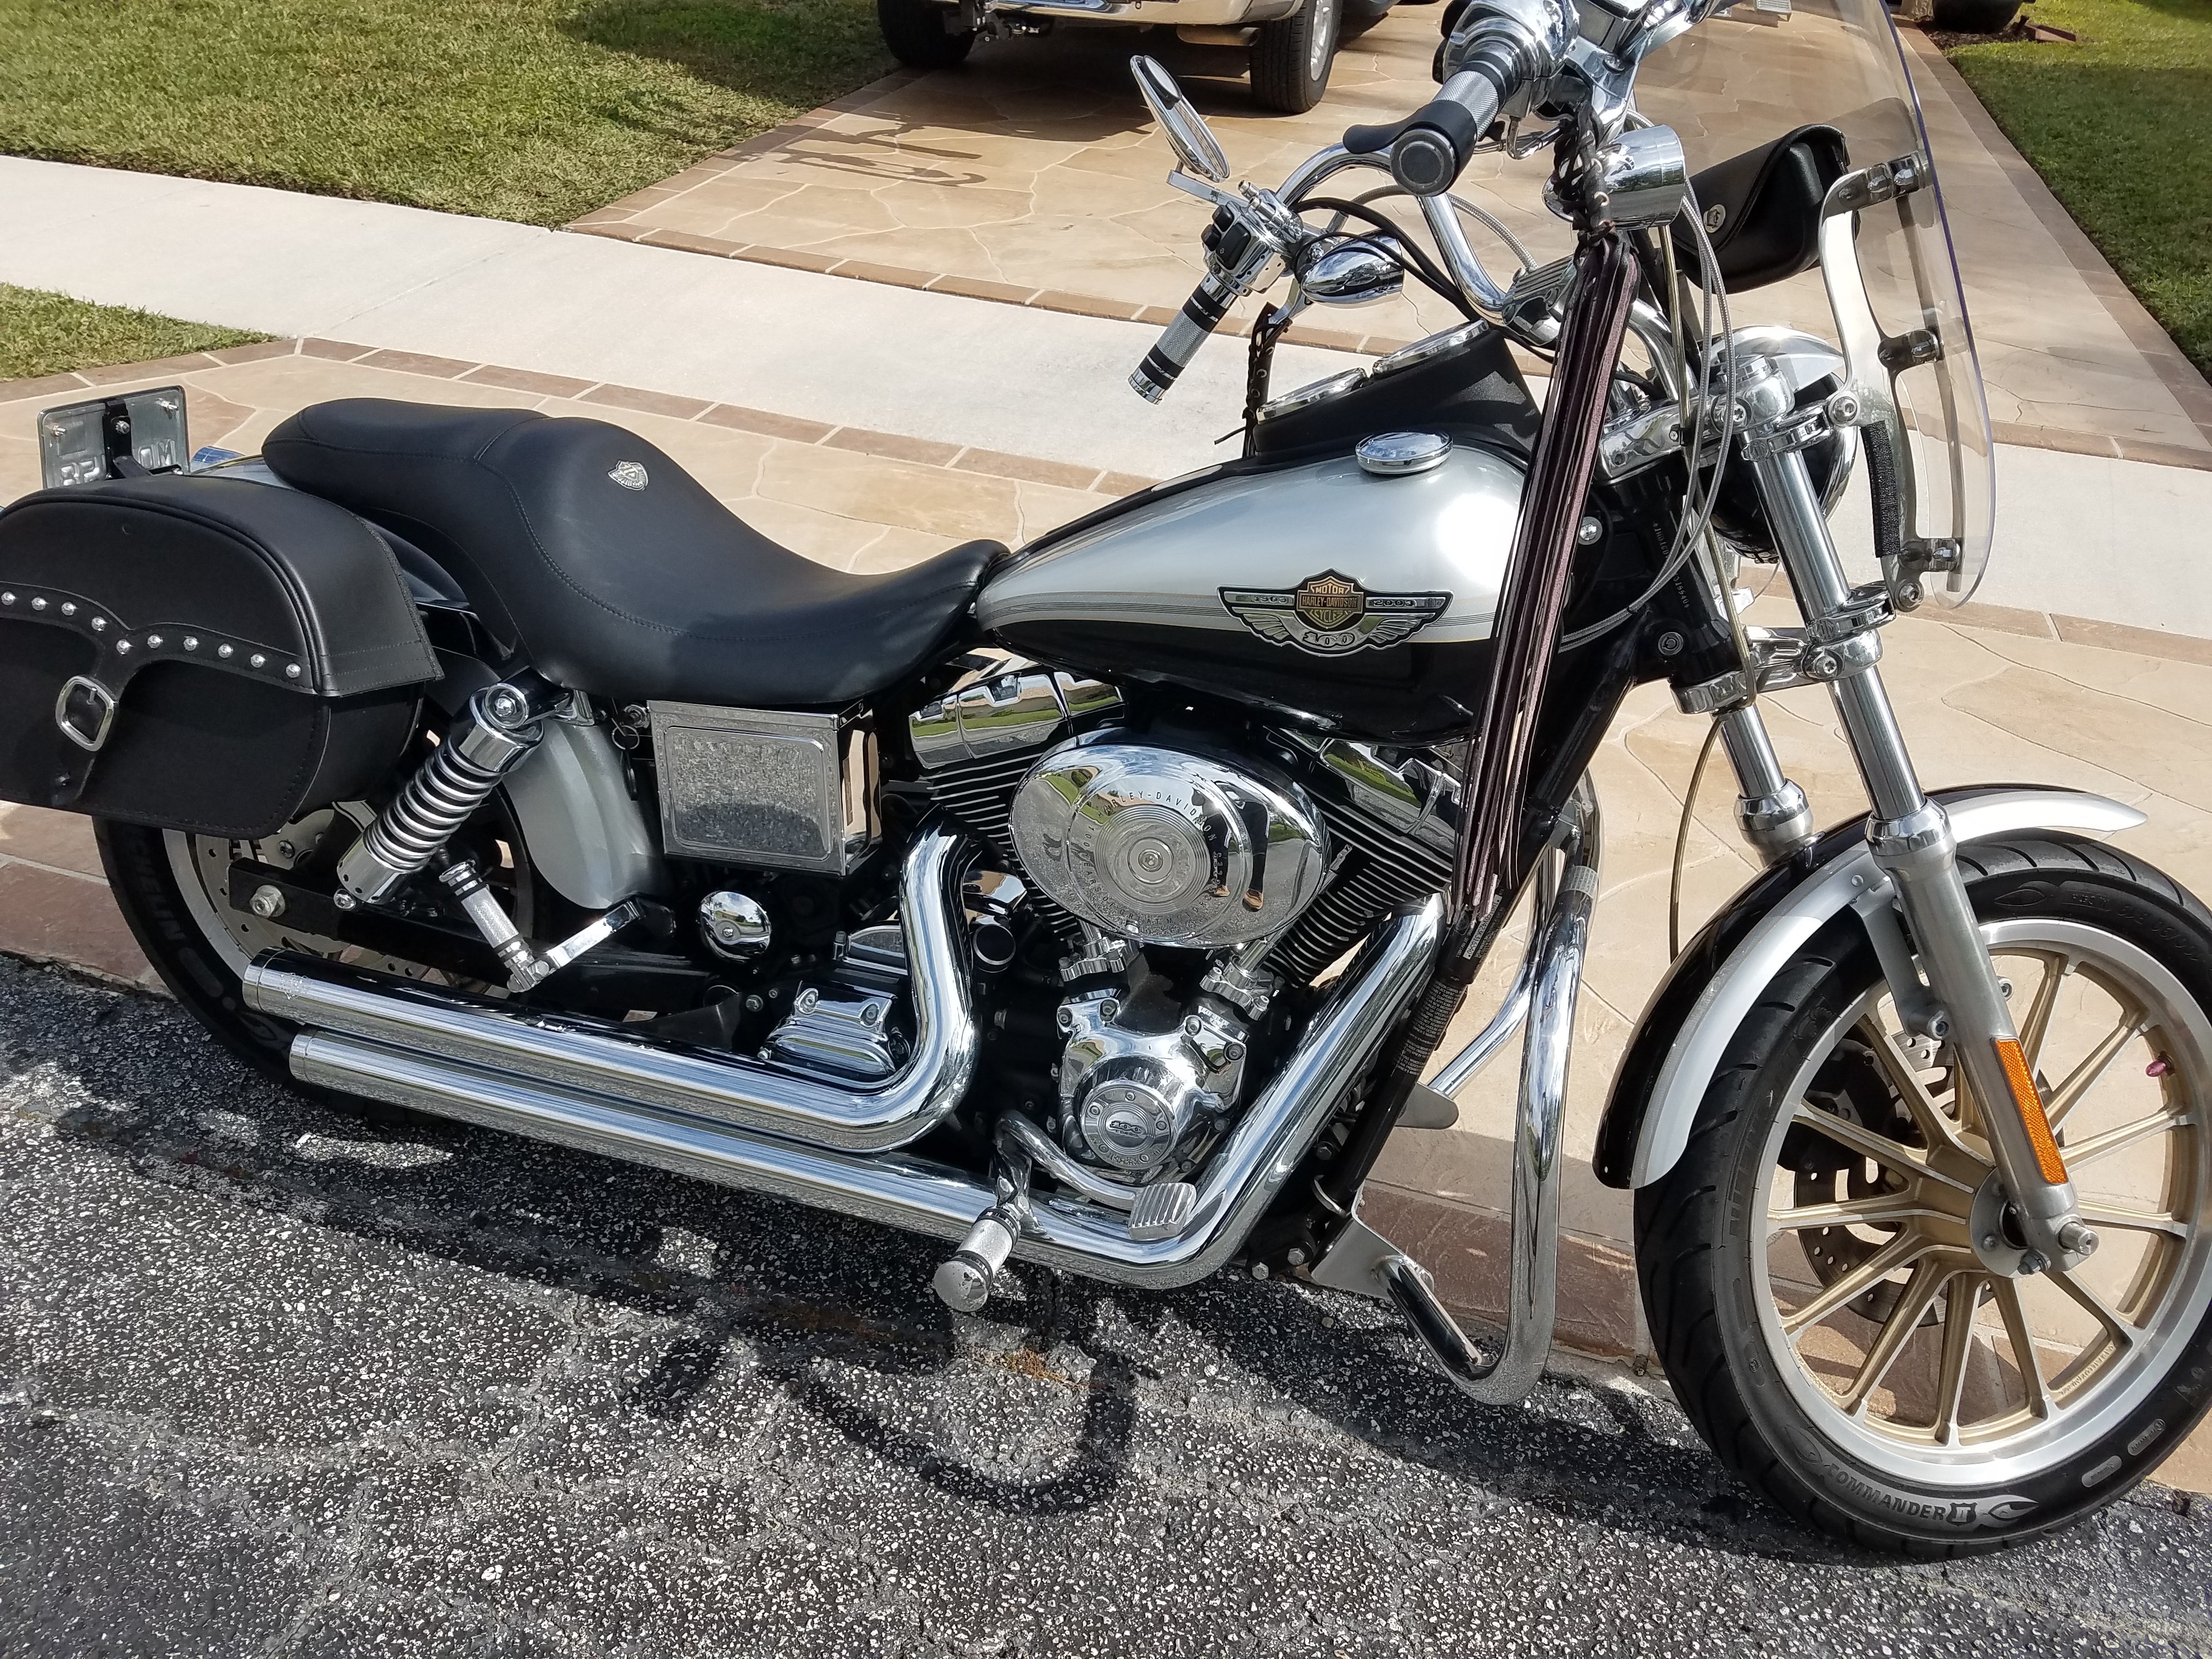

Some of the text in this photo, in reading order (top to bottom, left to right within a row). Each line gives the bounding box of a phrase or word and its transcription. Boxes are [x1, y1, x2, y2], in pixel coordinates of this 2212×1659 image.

[1316, 583, 1345, 594] MOTOR
[1302, 596, 1357, 608] HARLEY-DAVIDSON
[1314, 610, 1343, 623] CYCLES
[1302, 632, 1355, 648] 100
[1097, 791, 1217, 841] HARLEY-DAVIDSON
[1083, 826, 1095, 847] 100
[1081, 851, 1102, 892] YEARS
[1120, 909, 1160, 924] GREAT
[1110, 1120, 1143, 1133] 100
[1826, 1463, 1946, 1521] COMMANDER
